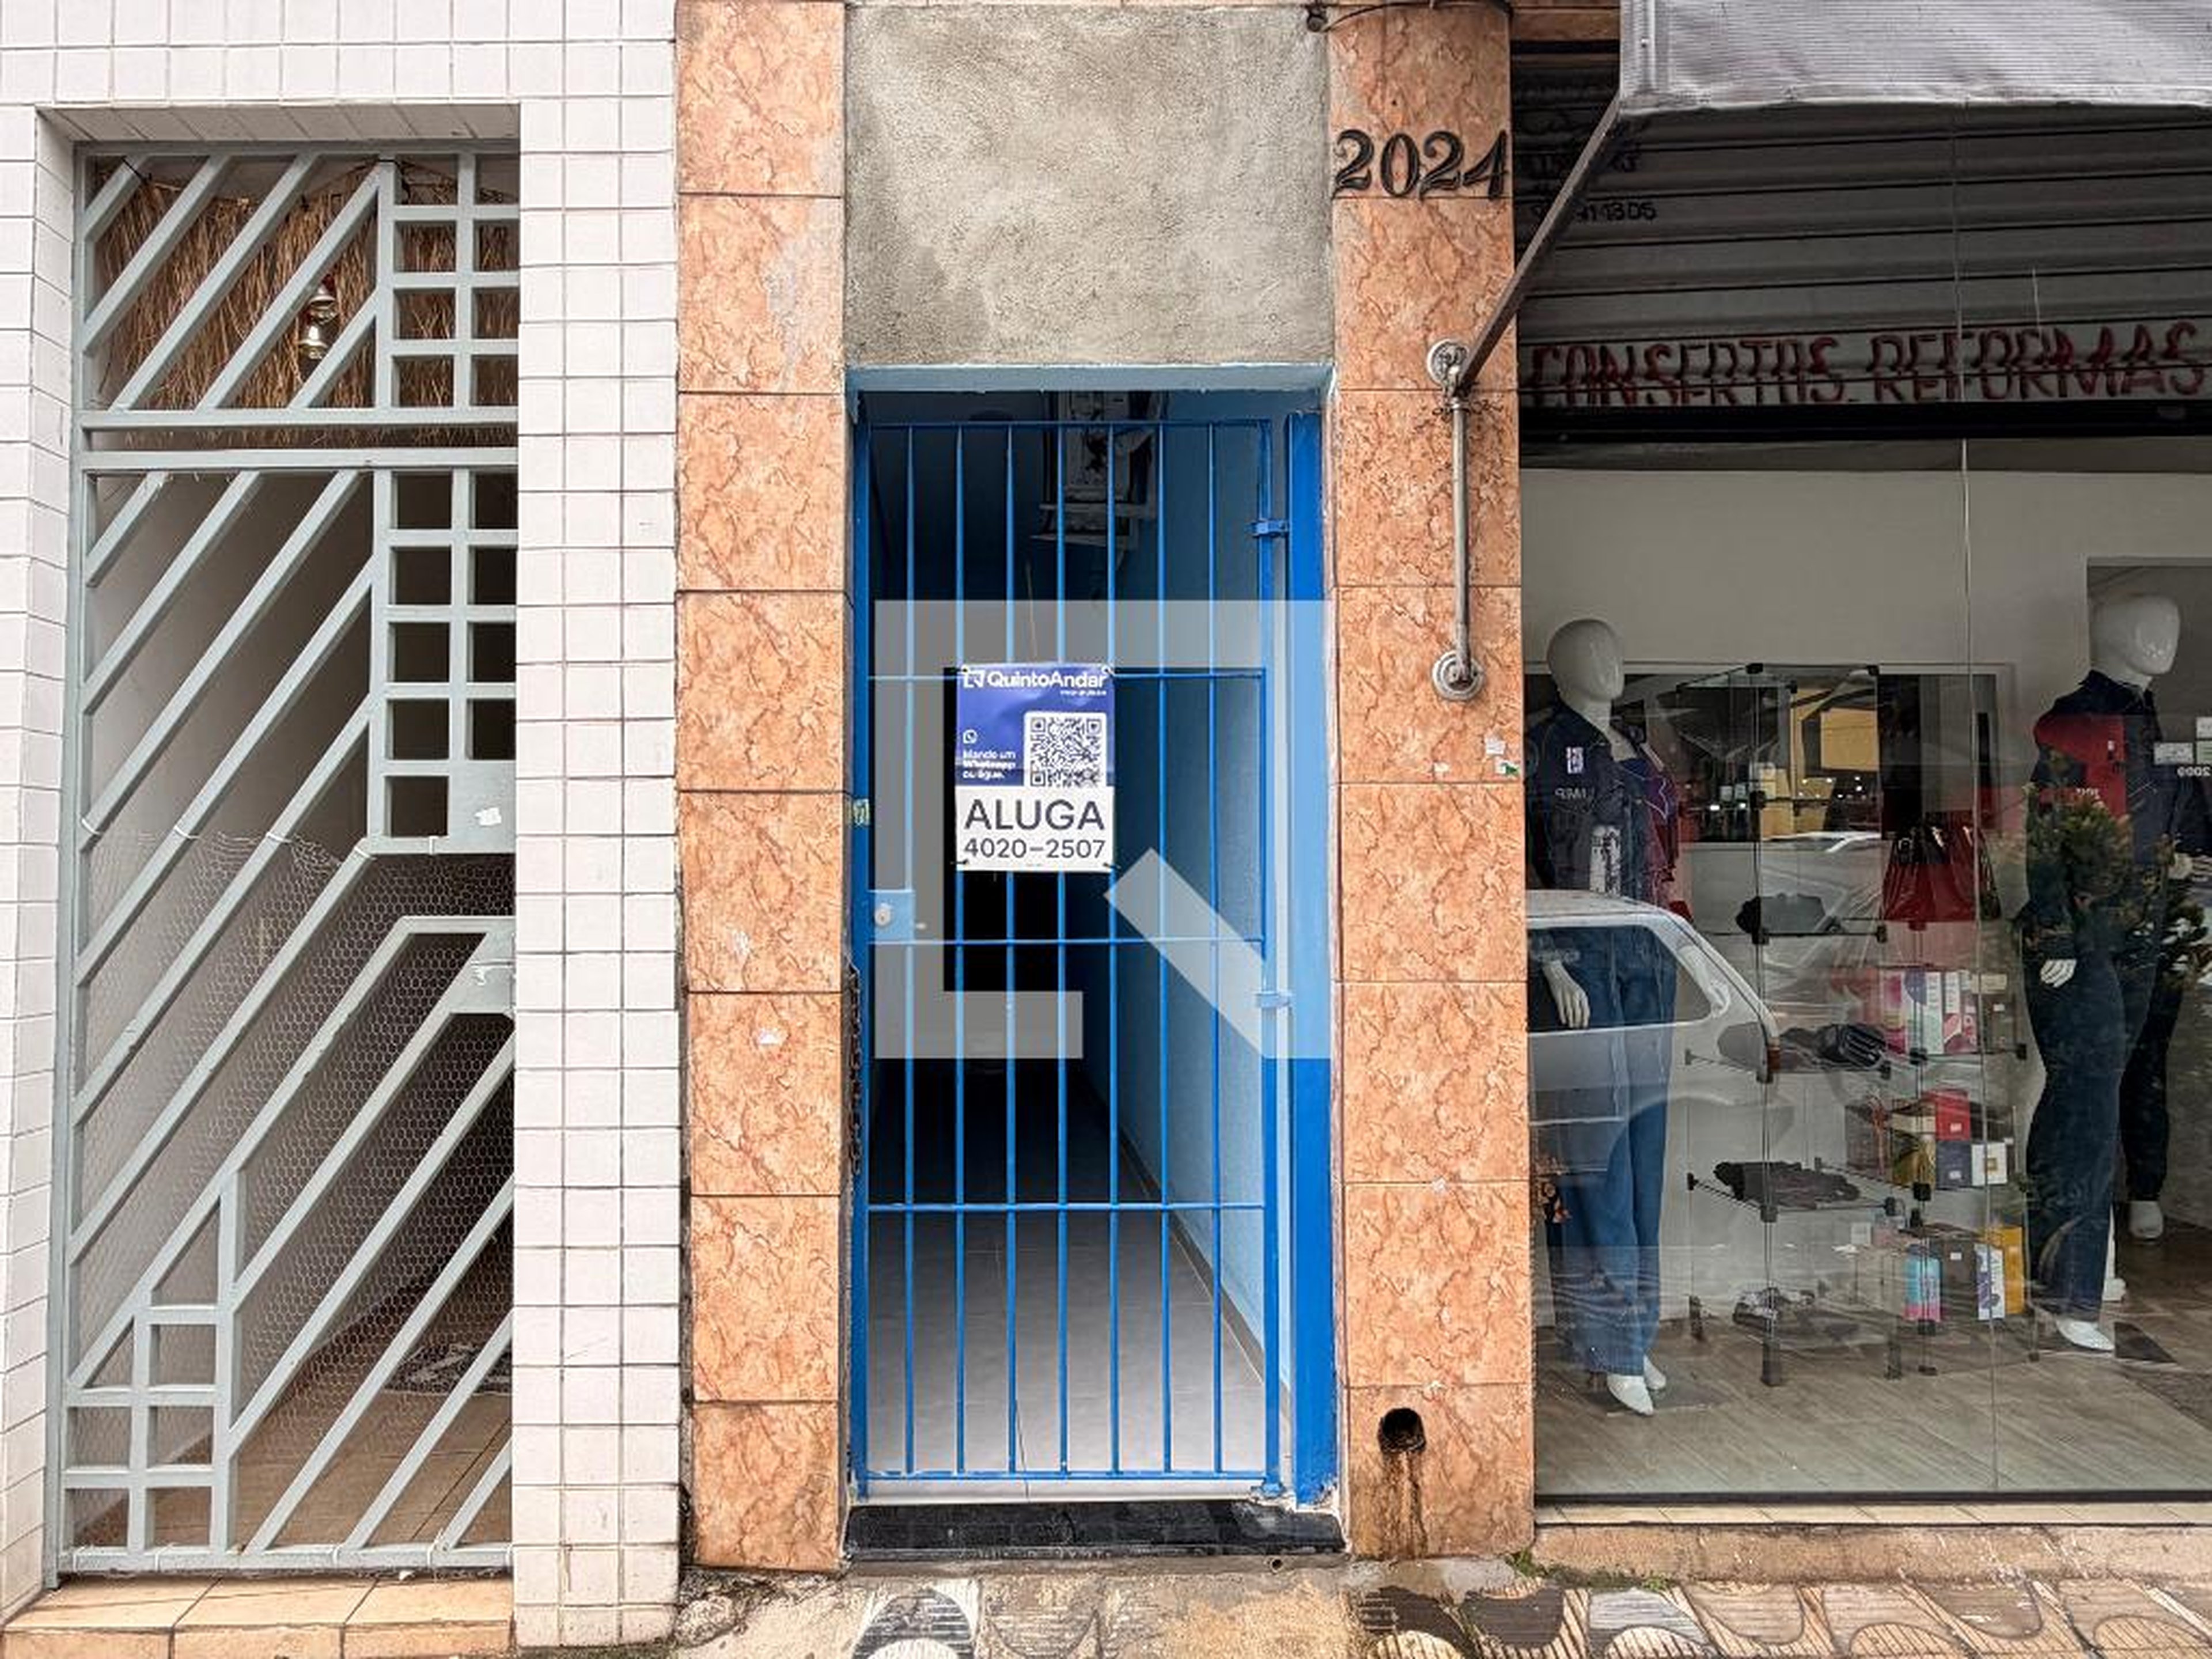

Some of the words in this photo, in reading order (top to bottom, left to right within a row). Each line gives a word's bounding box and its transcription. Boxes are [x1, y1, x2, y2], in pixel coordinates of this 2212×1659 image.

[1332, 129, 1509, 200] 2024
[987, 671, 1107, 688] QuintoAndar
[964, 798, 1105, 831] ALUGA
